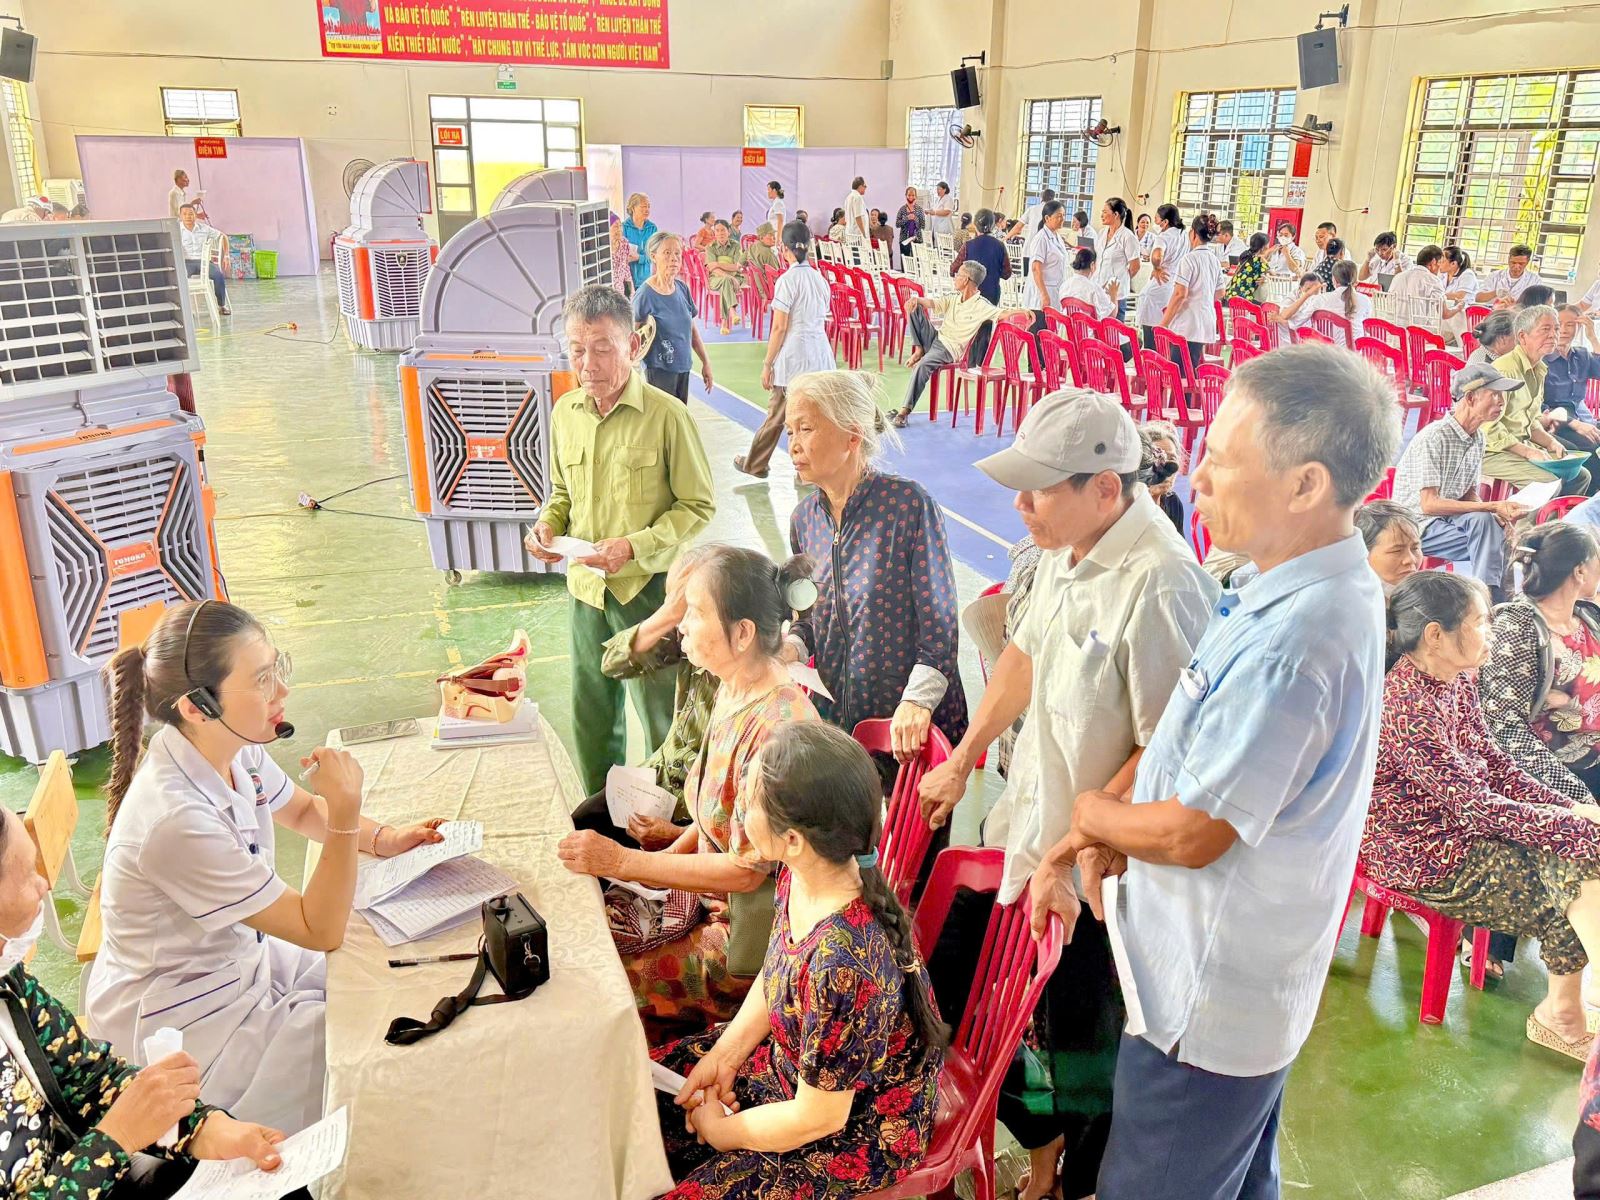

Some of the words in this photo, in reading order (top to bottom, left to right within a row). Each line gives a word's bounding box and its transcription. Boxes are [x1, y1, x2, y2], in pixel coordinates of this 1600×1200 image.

[410, 5, 420, 28] VỆ
[476, 8, 498, 31] LUYỆN
[499, 9, 516, 29] THÂN
[549, 11, 559, 34] VỆ
[611, 14, 631, 37] LUYỆN
[632, 15, 649, 34] THÂN
[387, 30, 405, 52] KIẾN
[405, 31, 425, 53] THIẾT
[487, 39, 512, 56] CHUNG
[512, 40, 523, 57] TAY
[577, 40, 591, 59] VÓC
[592, 43, 606, 60] CON
[607, 40, 627, 60] NGƯỜI
[628, 42, 642, 64] VIỆT
